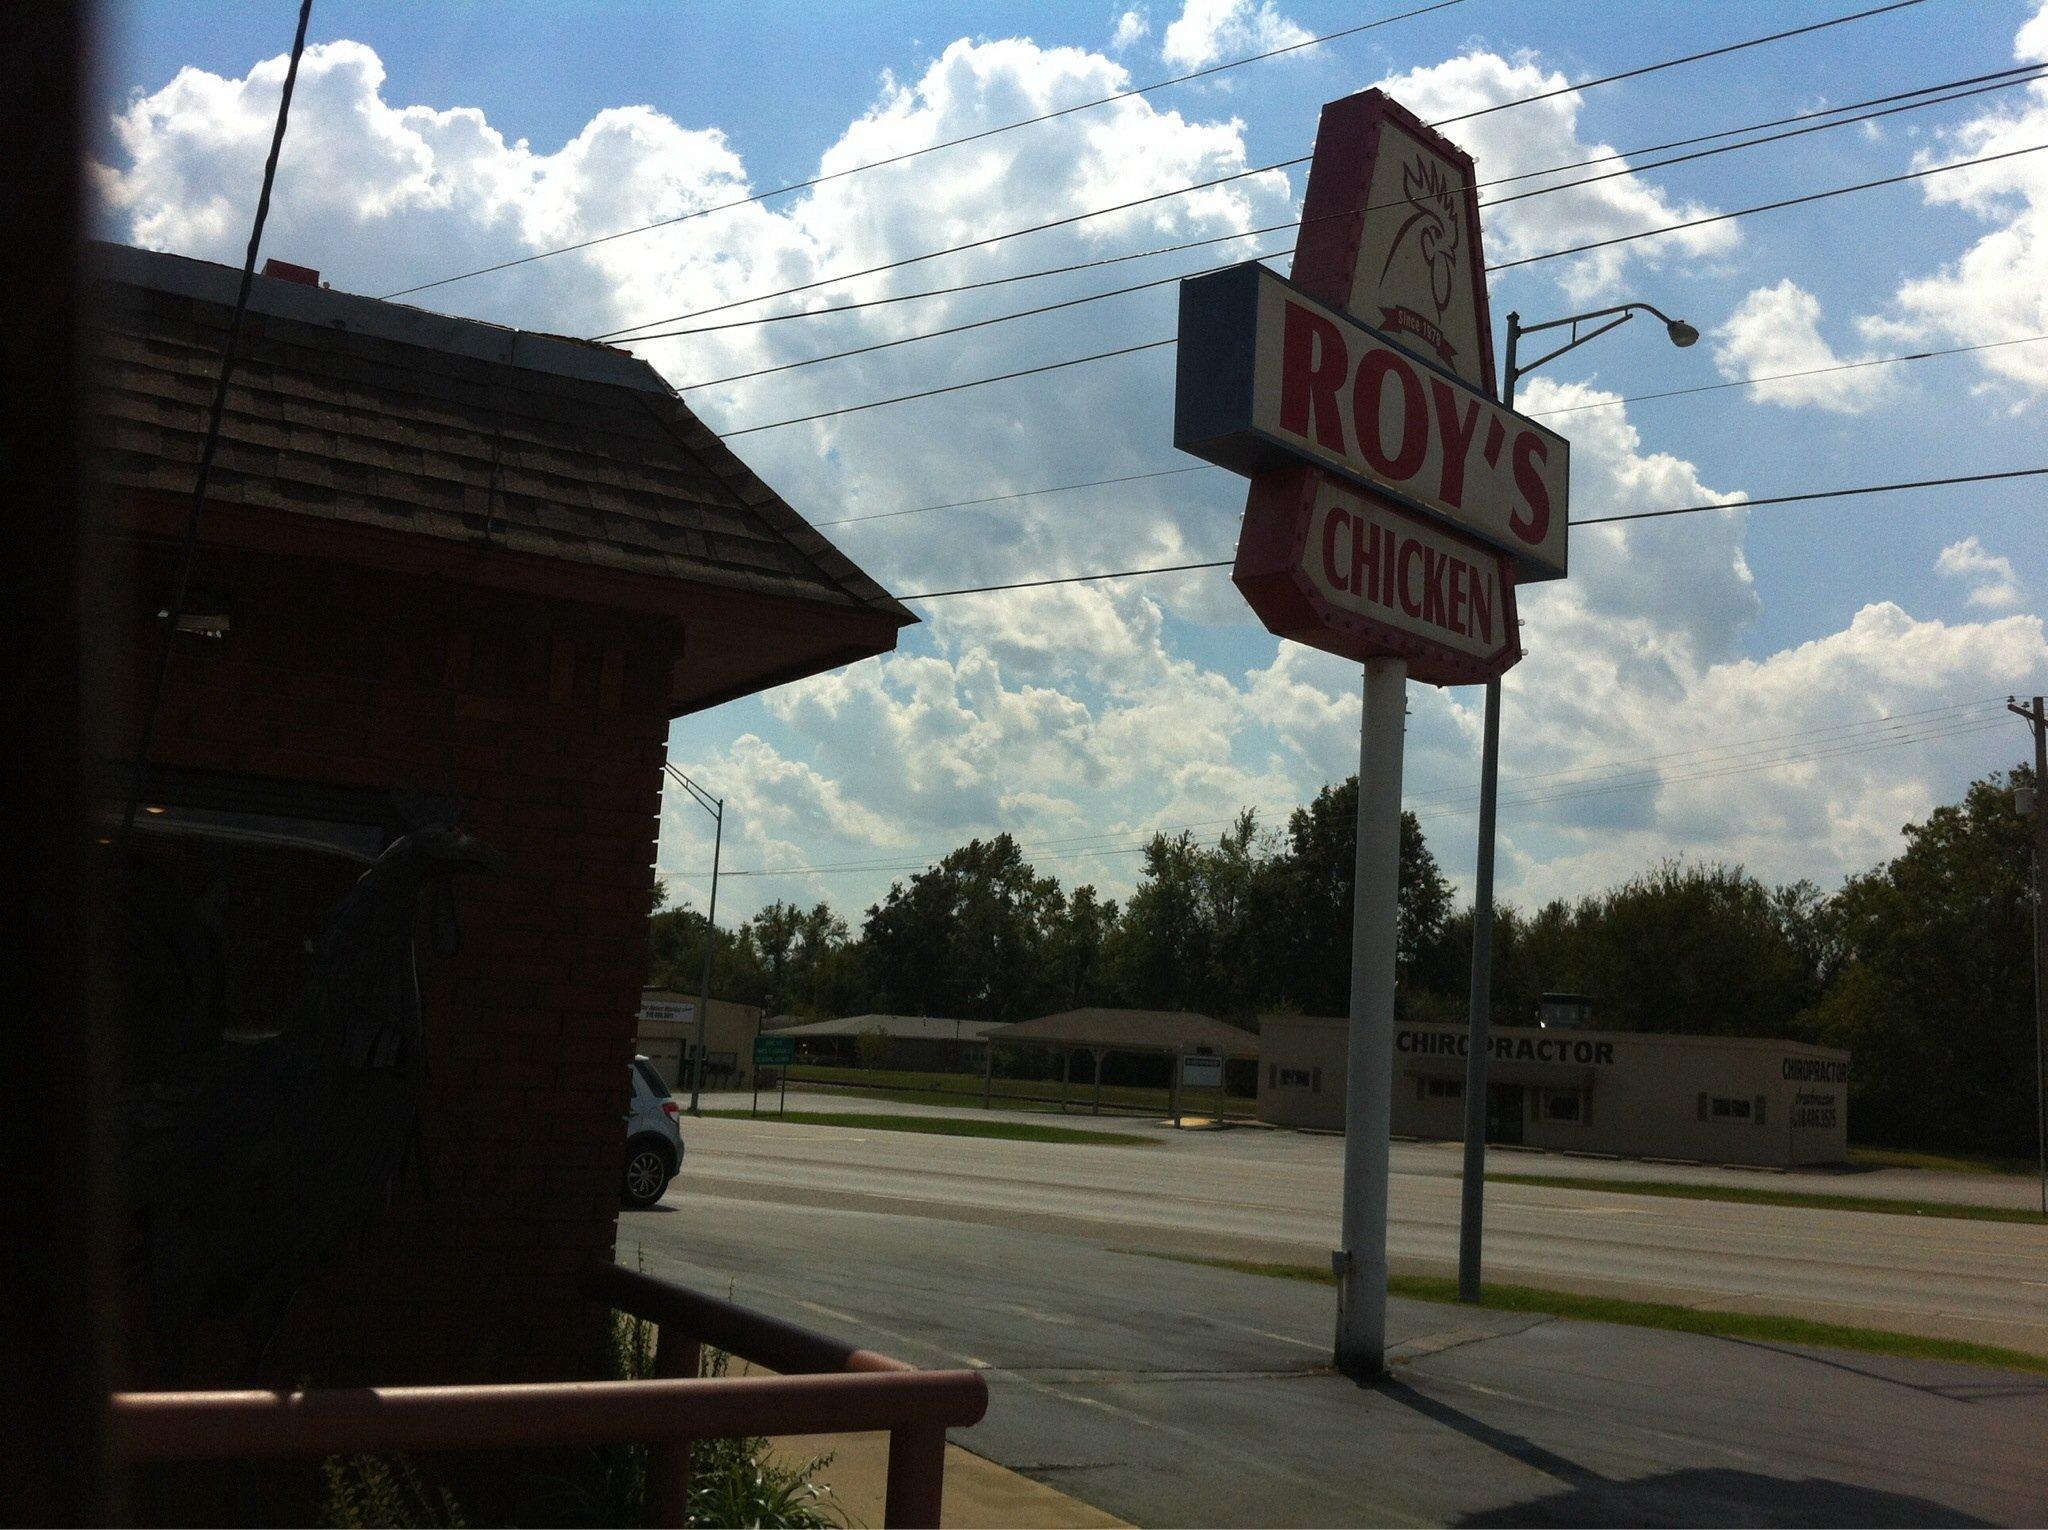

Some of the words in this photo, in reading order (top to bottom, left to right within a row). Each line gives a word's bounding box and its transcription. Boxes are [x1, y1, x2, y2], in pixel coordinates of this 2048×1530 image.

[1279, 300, 1550, 545] ROY'S
[1322, 506, 1493, 645] CHICKEN
[1783, 1057, 1846, 1083] CHIROPRACTOR
